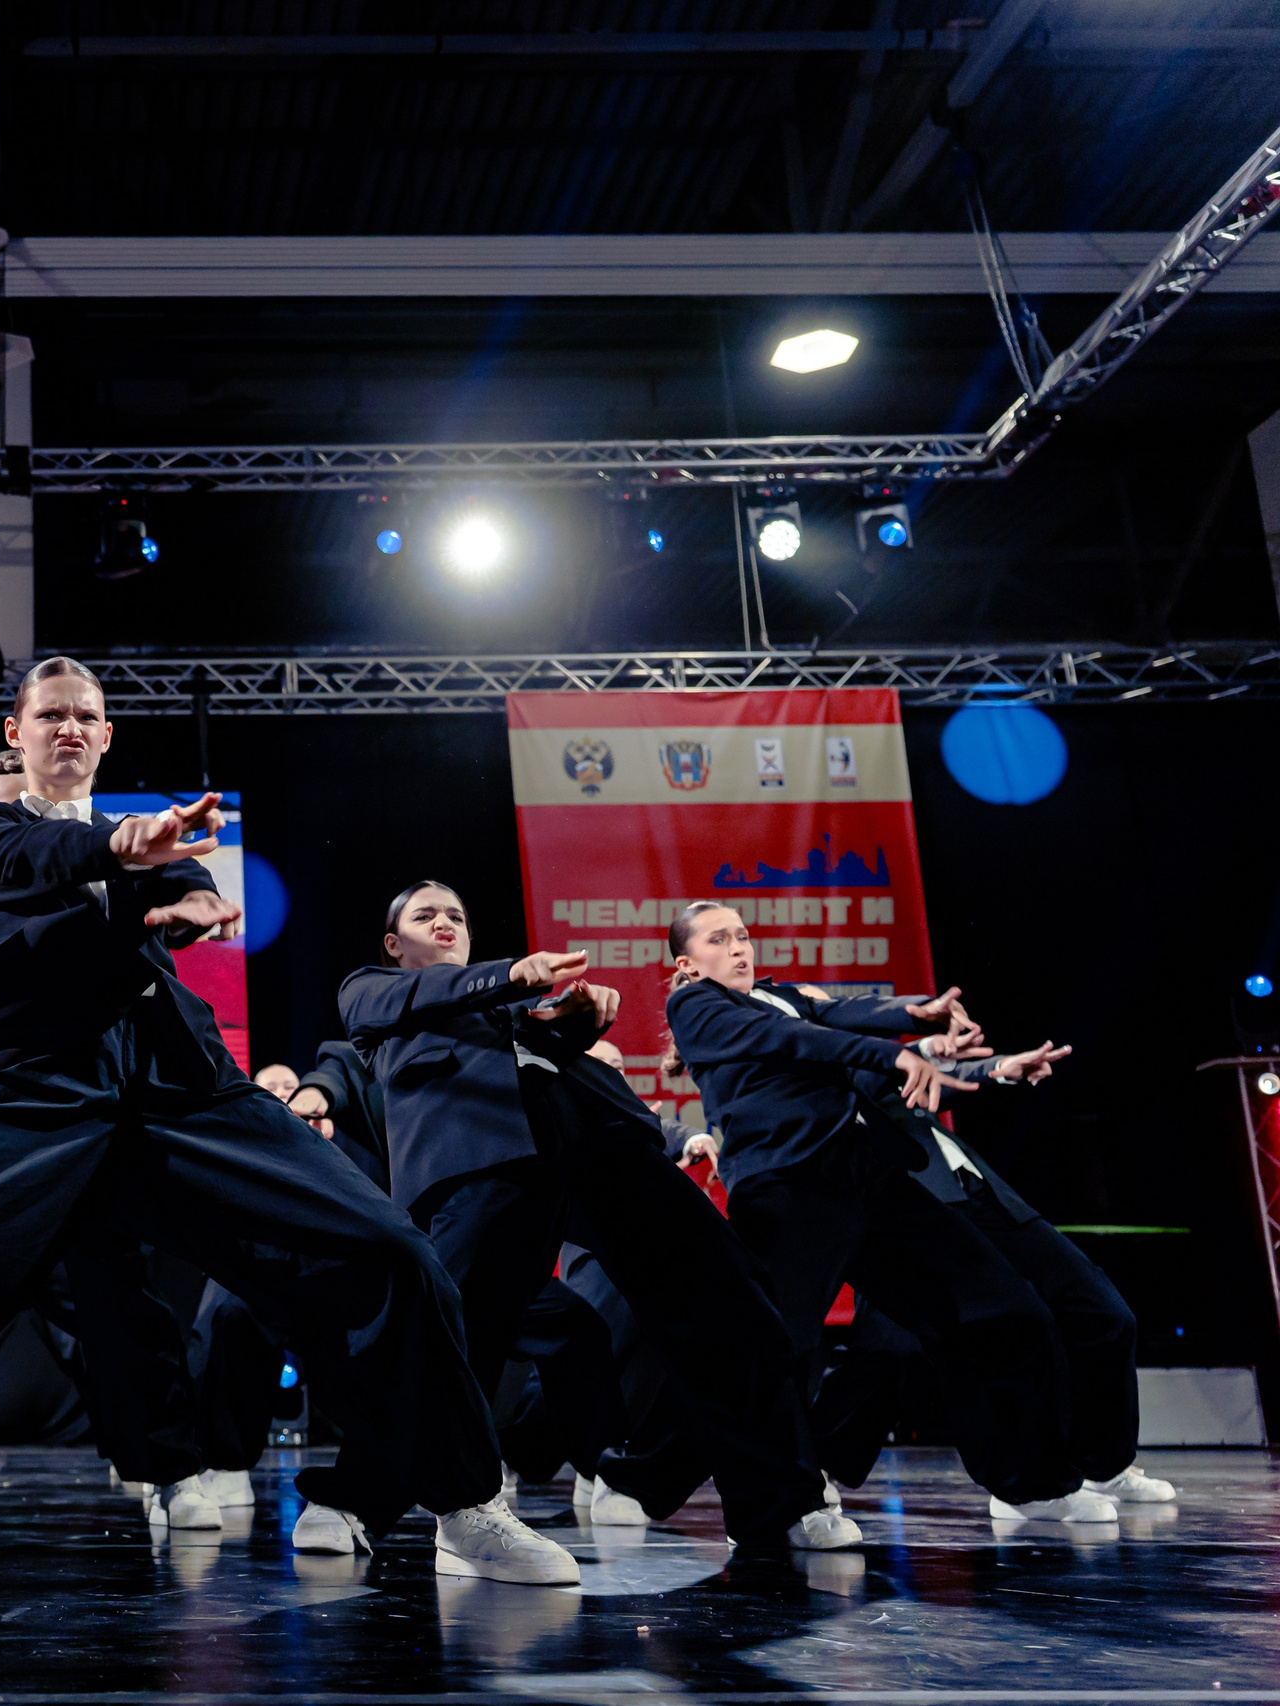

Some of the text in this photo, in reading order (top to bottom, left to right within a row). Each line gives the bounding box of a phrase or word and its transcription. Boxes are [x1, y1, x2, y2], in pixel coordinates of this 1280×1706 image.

[553, 897, 894, 927] ЧЕМПОНАТ И
[567, 938, 889, 967] ПЕРСТВО
